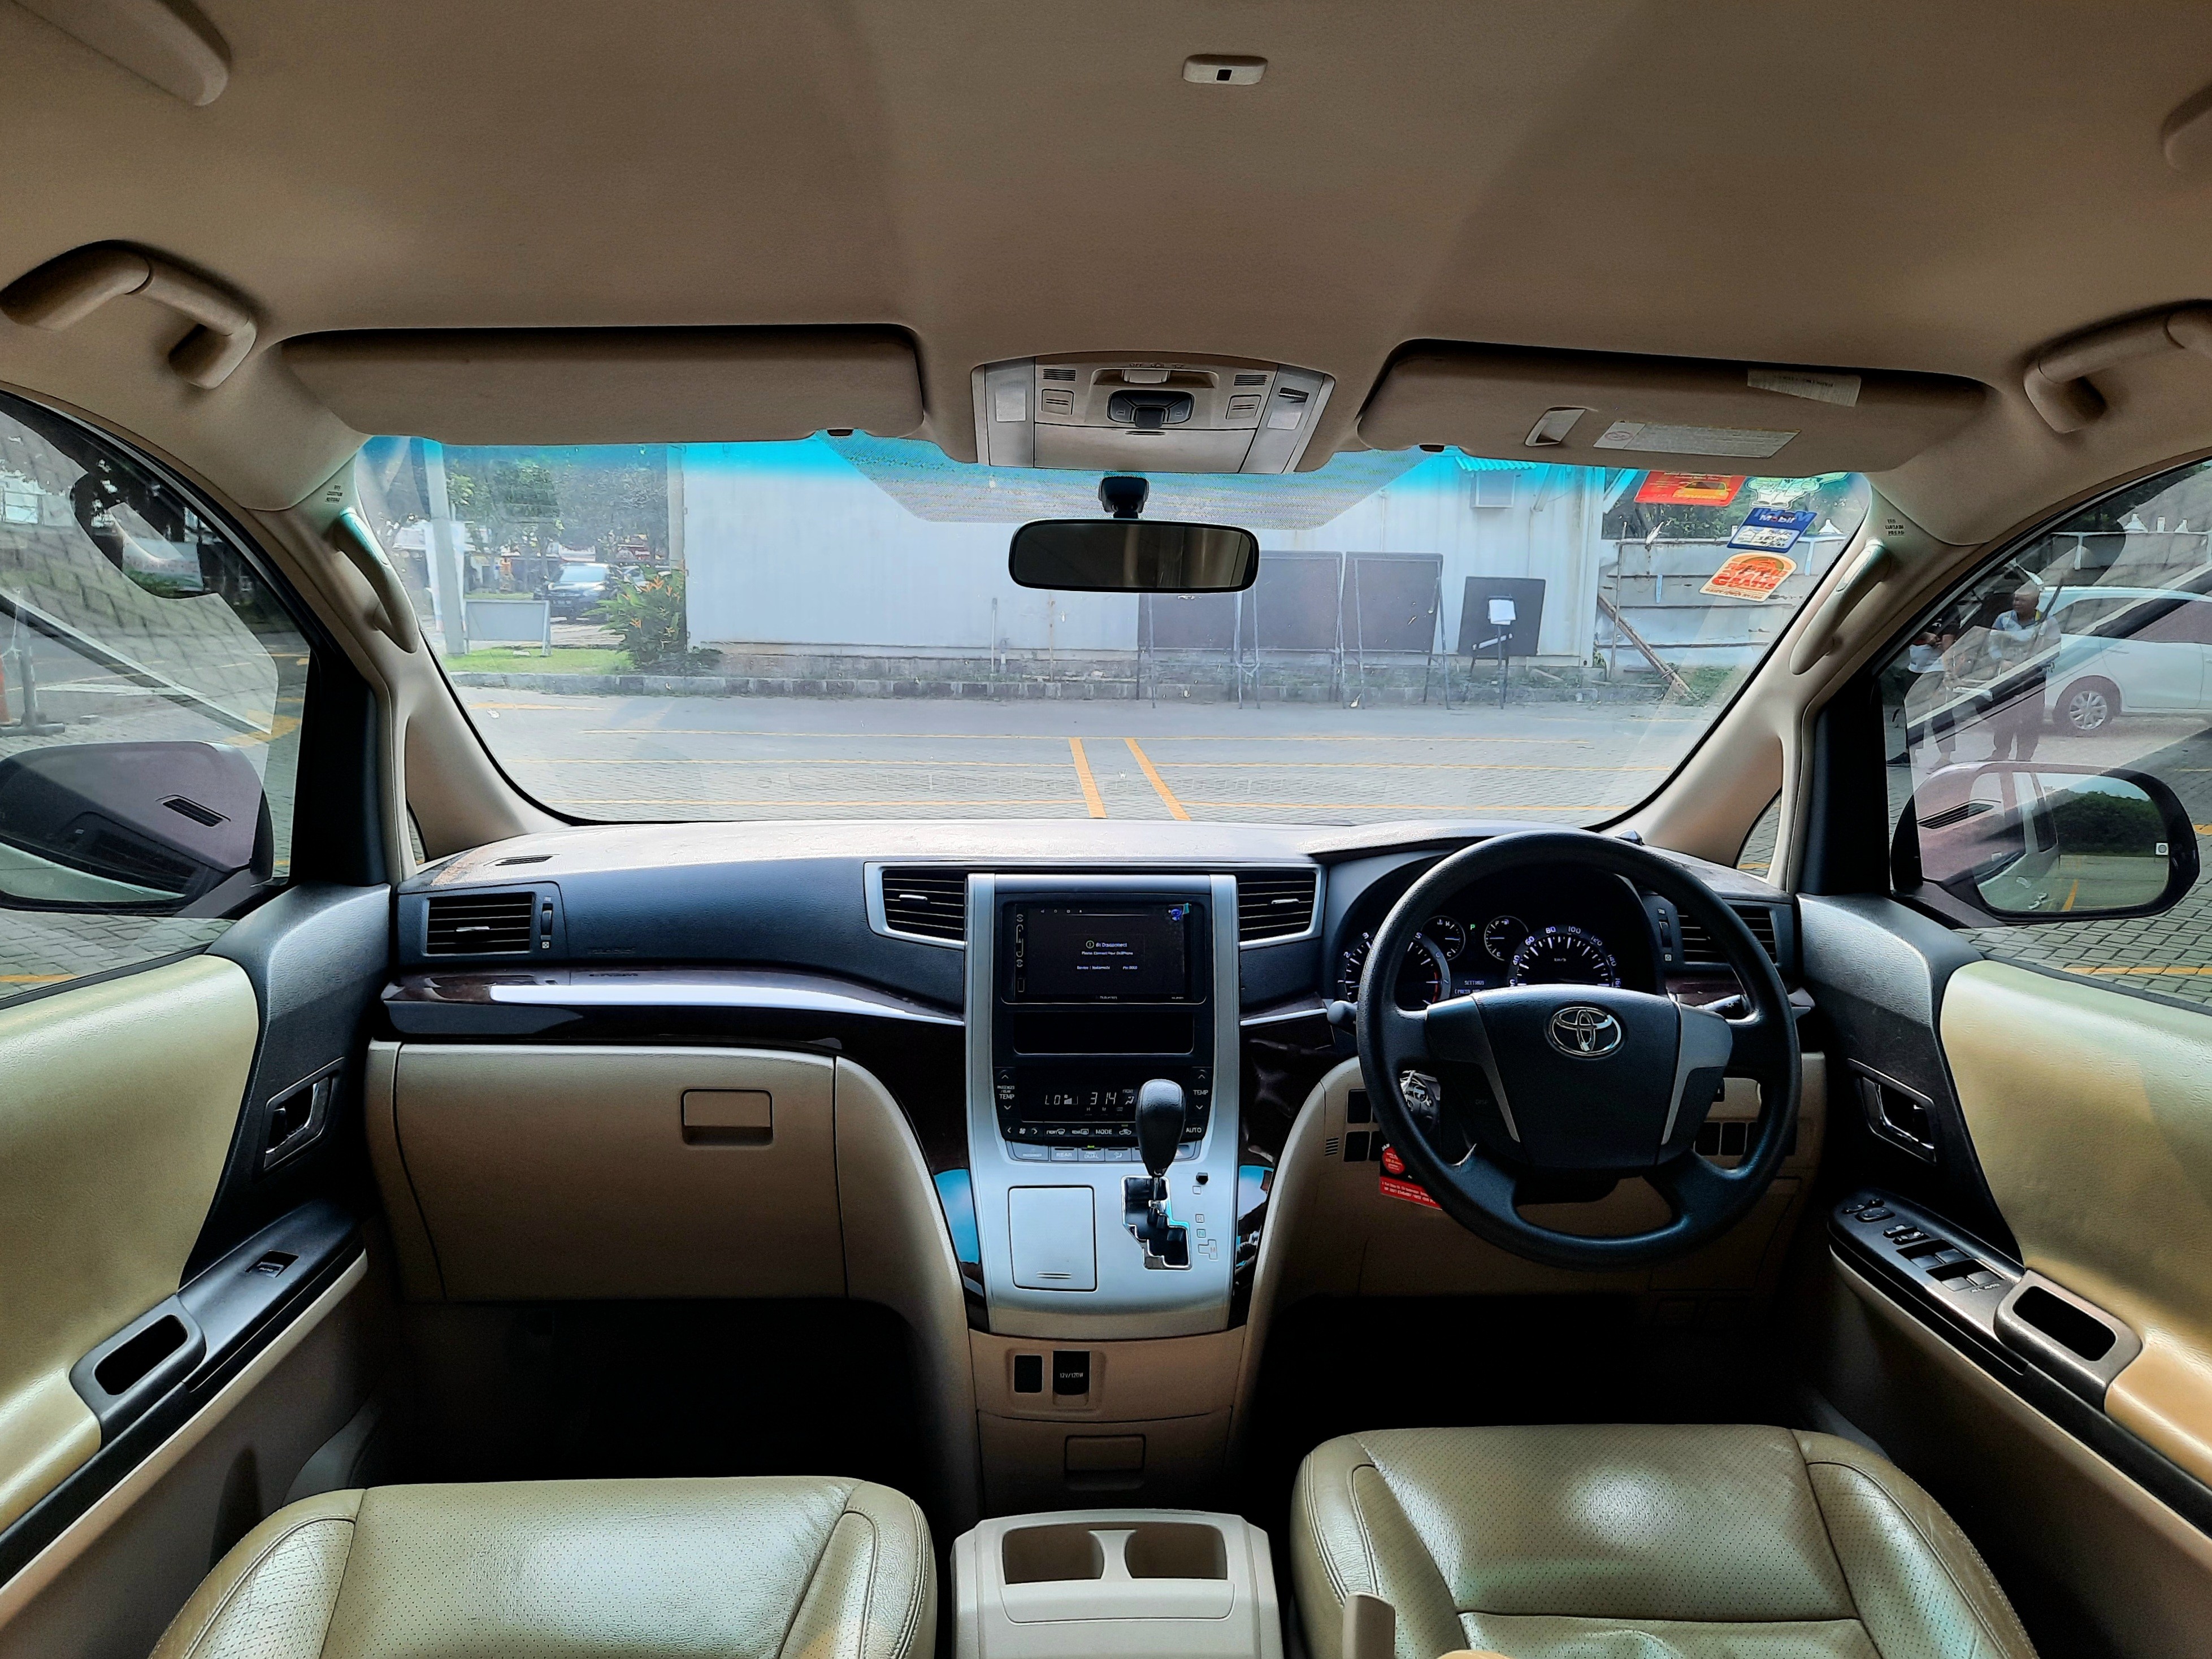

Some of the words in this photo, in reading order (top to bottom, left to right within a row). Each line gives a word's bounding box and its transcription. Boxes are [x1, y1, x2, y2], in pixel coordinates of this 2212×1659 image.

[1759, 515, 1797, 524] Mobil
[1525, 936, 1535, 946] 60
[1591, 935, 1603, 946] 120
[1512, 954, 1520, 966] 40
